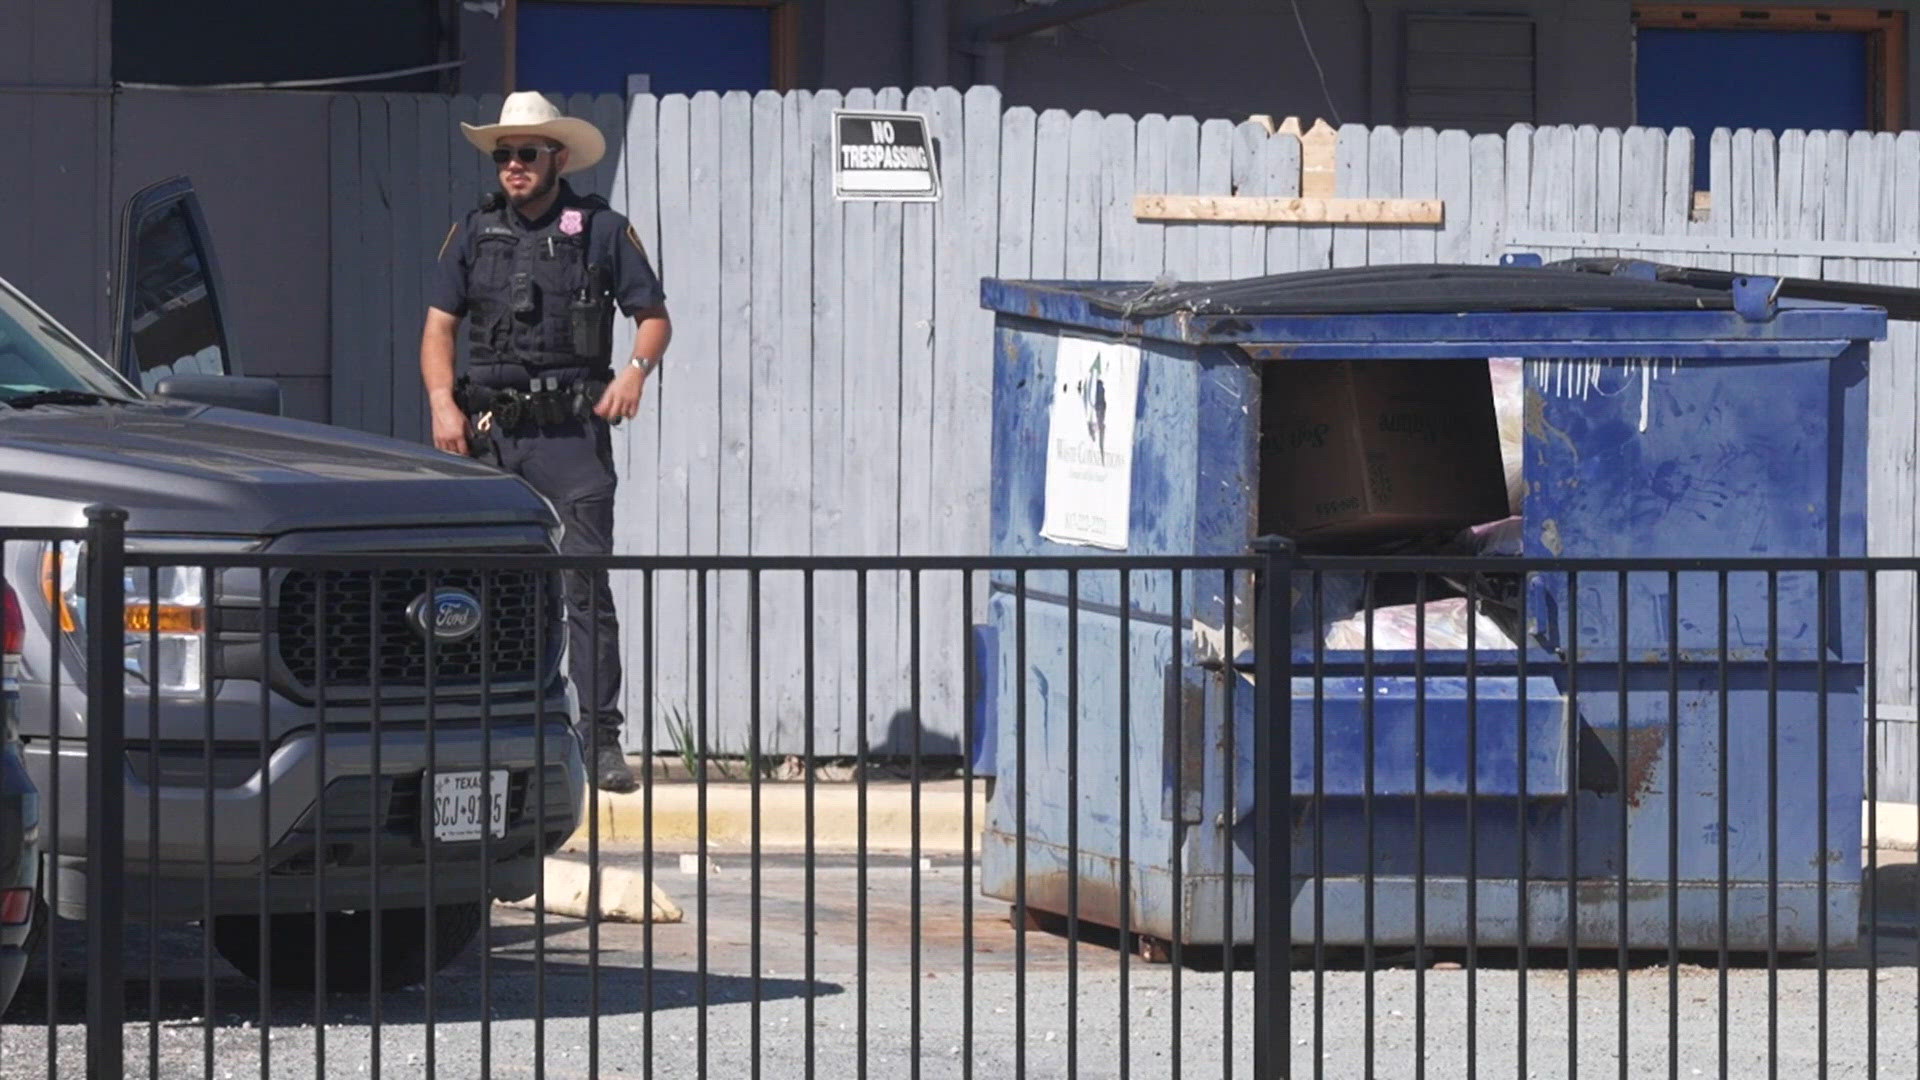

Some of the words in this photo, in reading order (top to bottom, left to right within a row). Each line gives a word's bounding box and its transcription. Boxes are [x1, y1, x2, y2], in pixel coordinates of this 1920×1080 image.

[870, 120, 896, 144] NO
[841, 144, 929, 169] TRESPASSING
[436, 602, 470, 627] Ford
